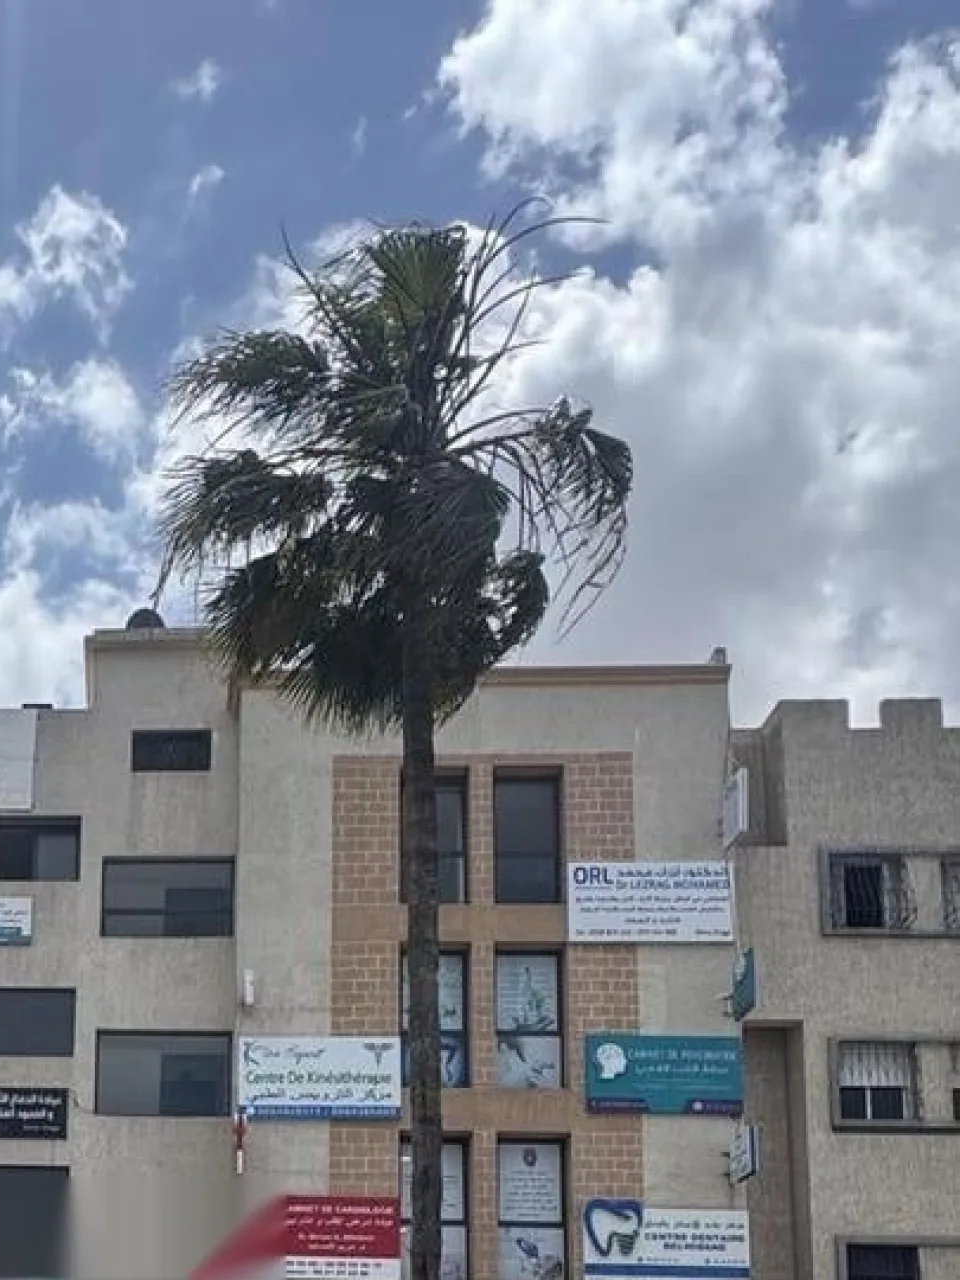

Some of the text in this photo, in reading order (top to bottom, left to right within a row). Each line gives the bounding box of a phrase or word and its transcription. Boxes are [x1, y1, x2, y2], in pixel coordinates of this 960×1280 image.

[574, 867, 614, 885] ORL
[246, 1070, 285, 1084] Centre
[288, 1071, 304, 1084] De
[644, 1231, 745, 1243] CENTRE DENTAIRE
